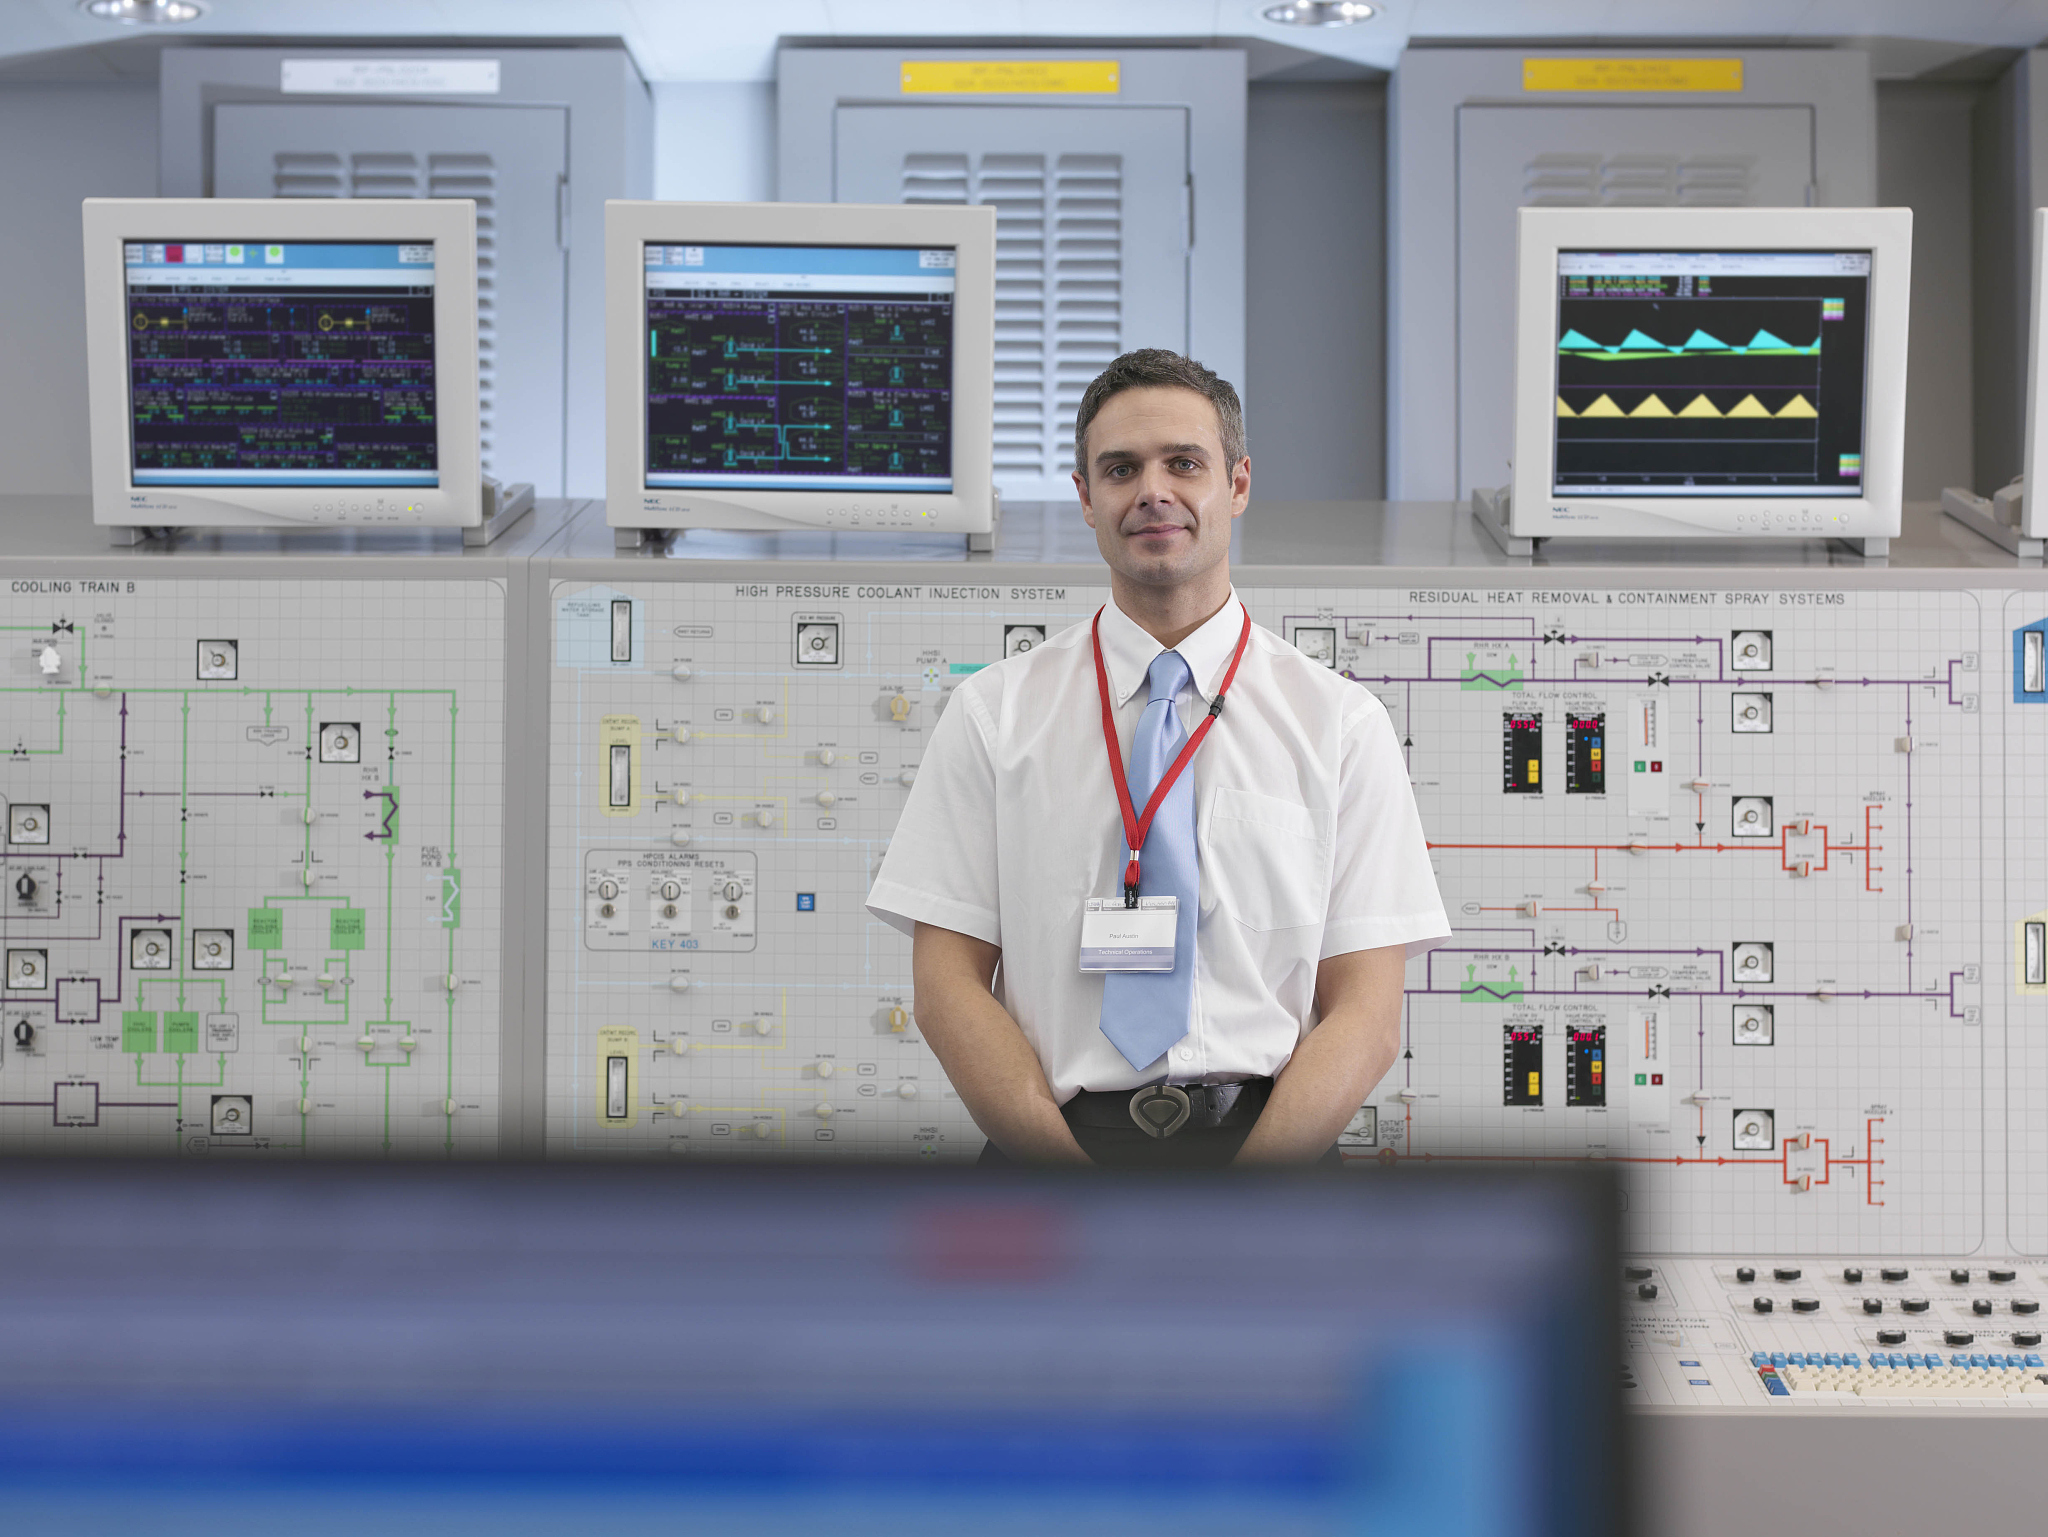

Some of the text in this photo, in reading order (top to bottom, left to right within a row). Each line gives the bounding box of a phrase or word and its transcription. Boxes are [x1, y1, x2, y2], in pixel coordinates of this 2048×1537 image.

[12, 582, 135, 593] COOLING TRAIN B
[736, 586, 1066, 600] HIGH PRESSURE COOLANT INJECTION SYSTEM
[1410, 591, 1845, 605] RESIDUAL HEAT REMOVAL & CONTAINMENT SPRAY SYSTEMS
[652, 939, 699, 949] KEY 403
